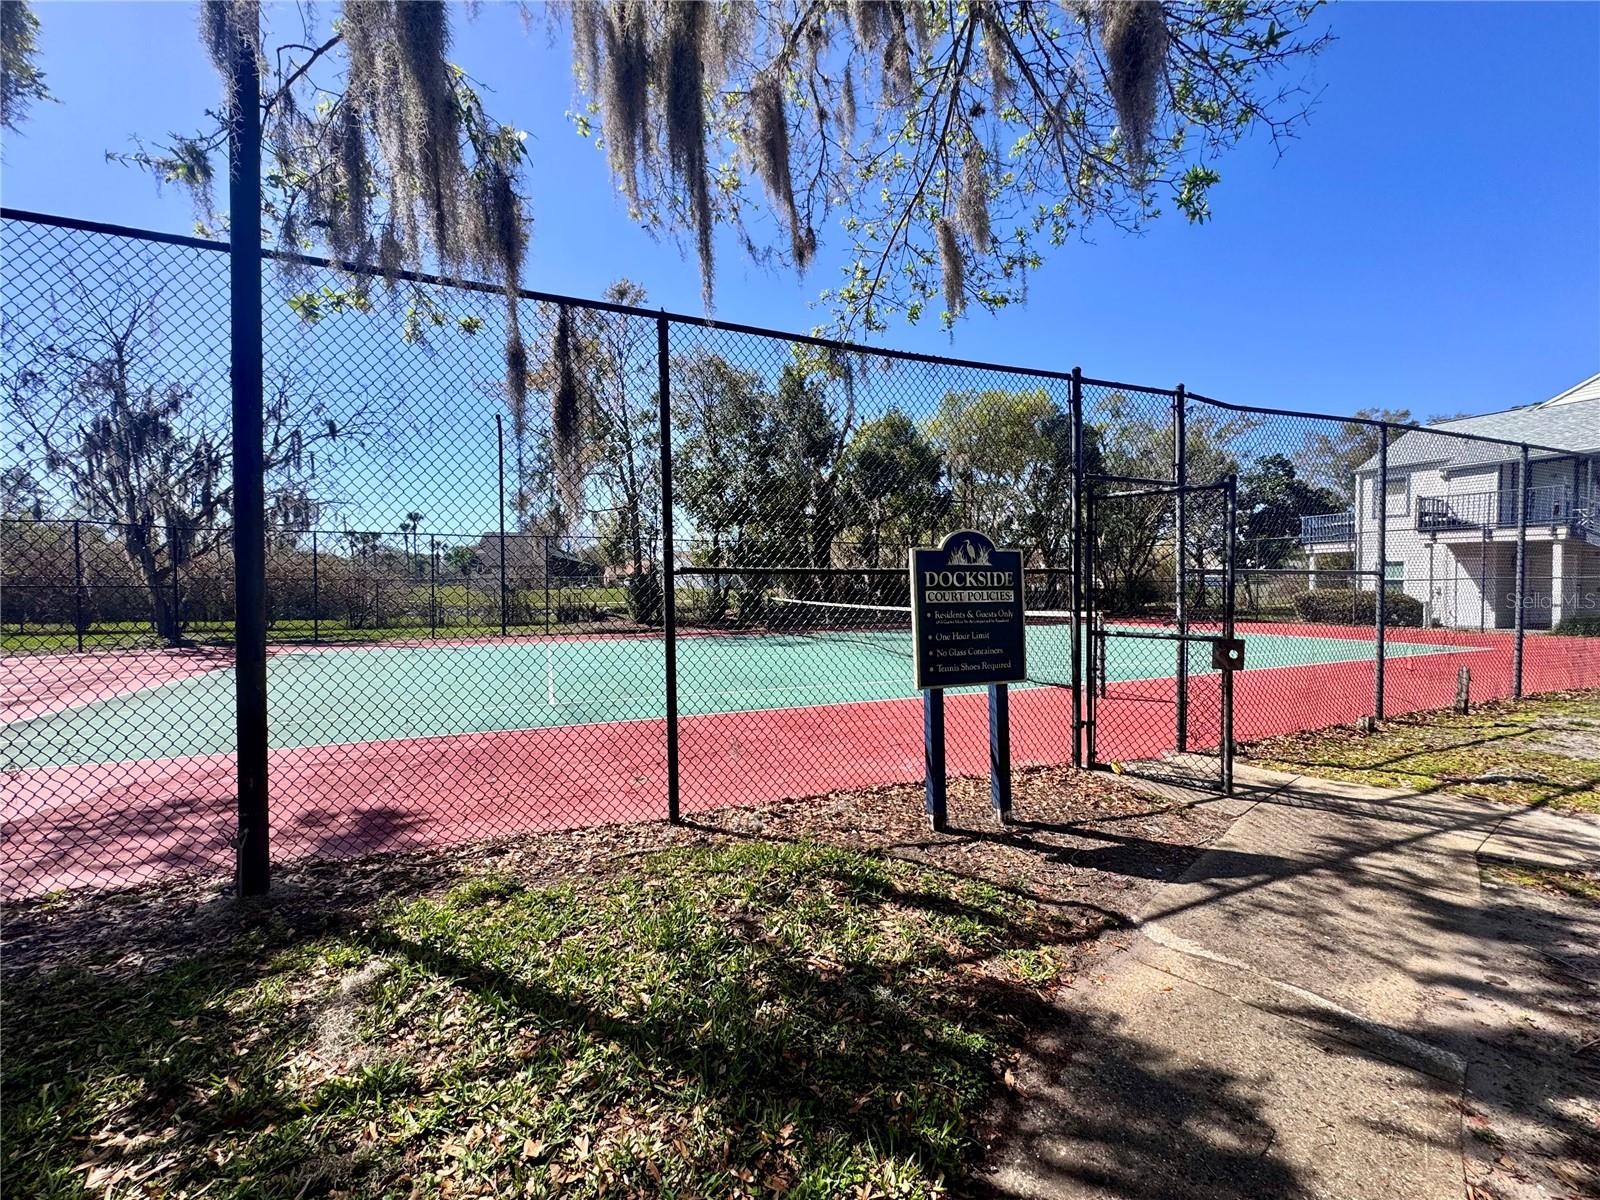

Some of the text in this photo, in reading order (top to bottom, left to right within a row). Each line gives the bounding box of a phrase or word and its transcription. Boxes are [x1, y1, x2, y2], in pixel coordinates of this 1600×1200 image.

[924, 571, 1014, 587] DOCKSIDE
[927, 591, 1013, 602] COURT POLICIES:
[934, 609, 1013, 619] Residents & Guests Only
[935, 632, 990, 641] One Hour Limit
[936, 647, 1003, 657] No Glass Containers
[937, 661, 1012, 672] Tennis Shoes Required
